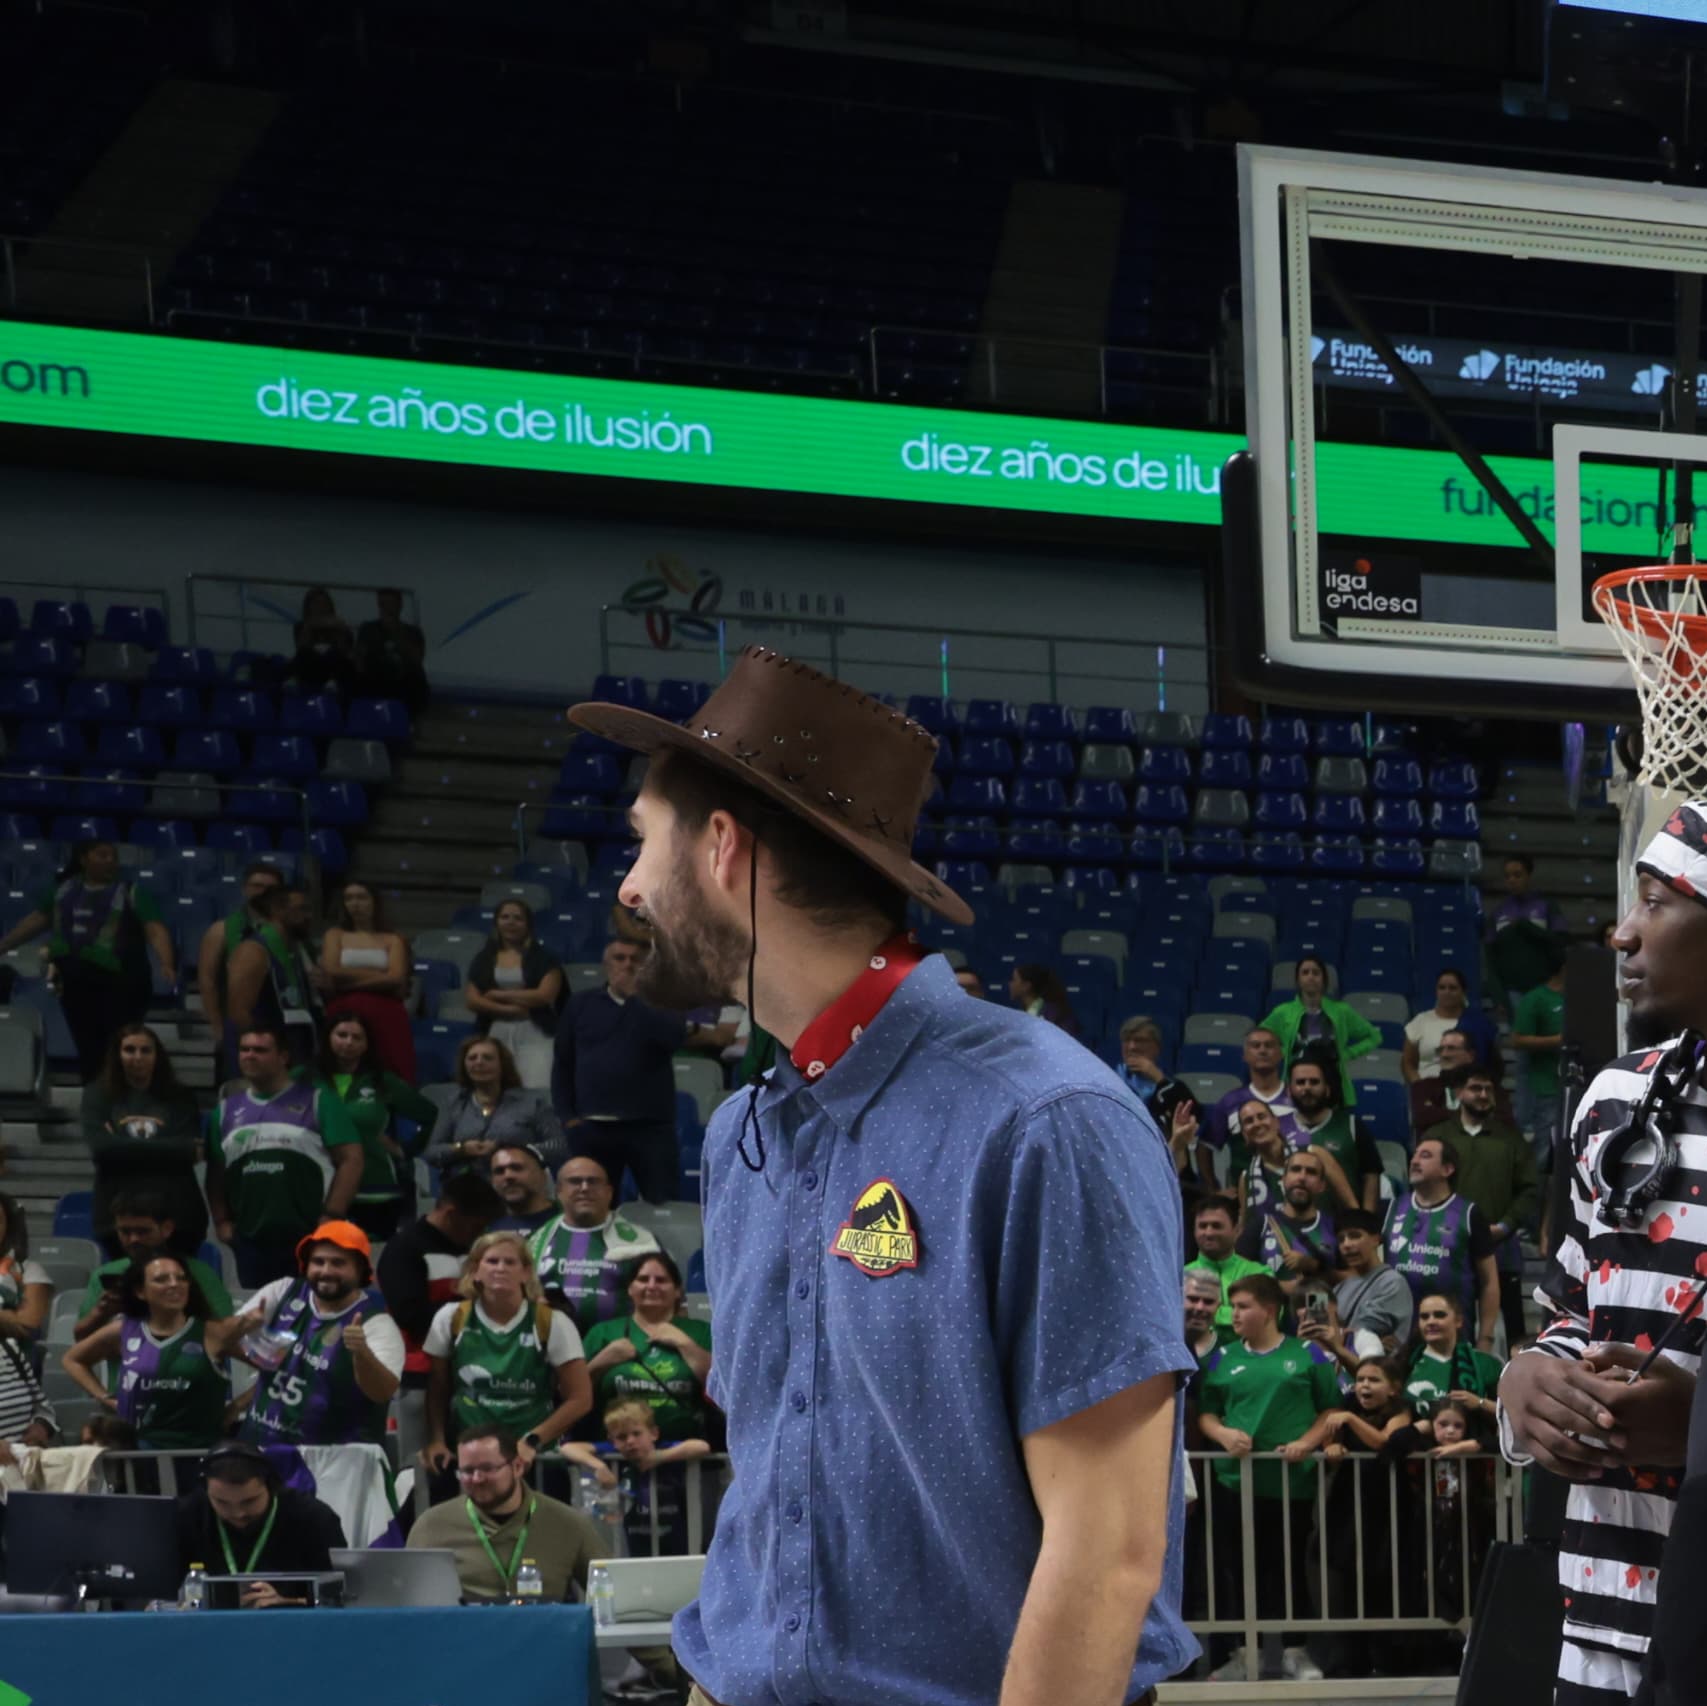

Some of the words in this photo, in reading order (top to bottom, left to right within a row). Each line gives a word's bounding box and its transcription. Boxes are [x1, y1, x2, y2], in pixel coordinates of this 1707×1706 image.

[1506, 353, 1605, 382] Fundación
[256, 377, 360, 425] diez
[367, 387, 488, 437] años
[495, 399, 556, 441] de
[564, 402, 713, 455] ilusión
[901, 432, 992, 477] diez
[1000, 440, 1107, 486] años
[1113, 451, 1169, 491] de
[1175, 454, 1221, 496] ilu
[1325, 568, 1368, 594] liga
[1325, 592, 1419, 616] endesa
[840, 1230, 884, 1253] JURASSIC
[888, 1235, 914, 1257] PARK
[1407, 1242, 1452, 1259] Unicaja
[267, 1369, 307, 1406] 55
